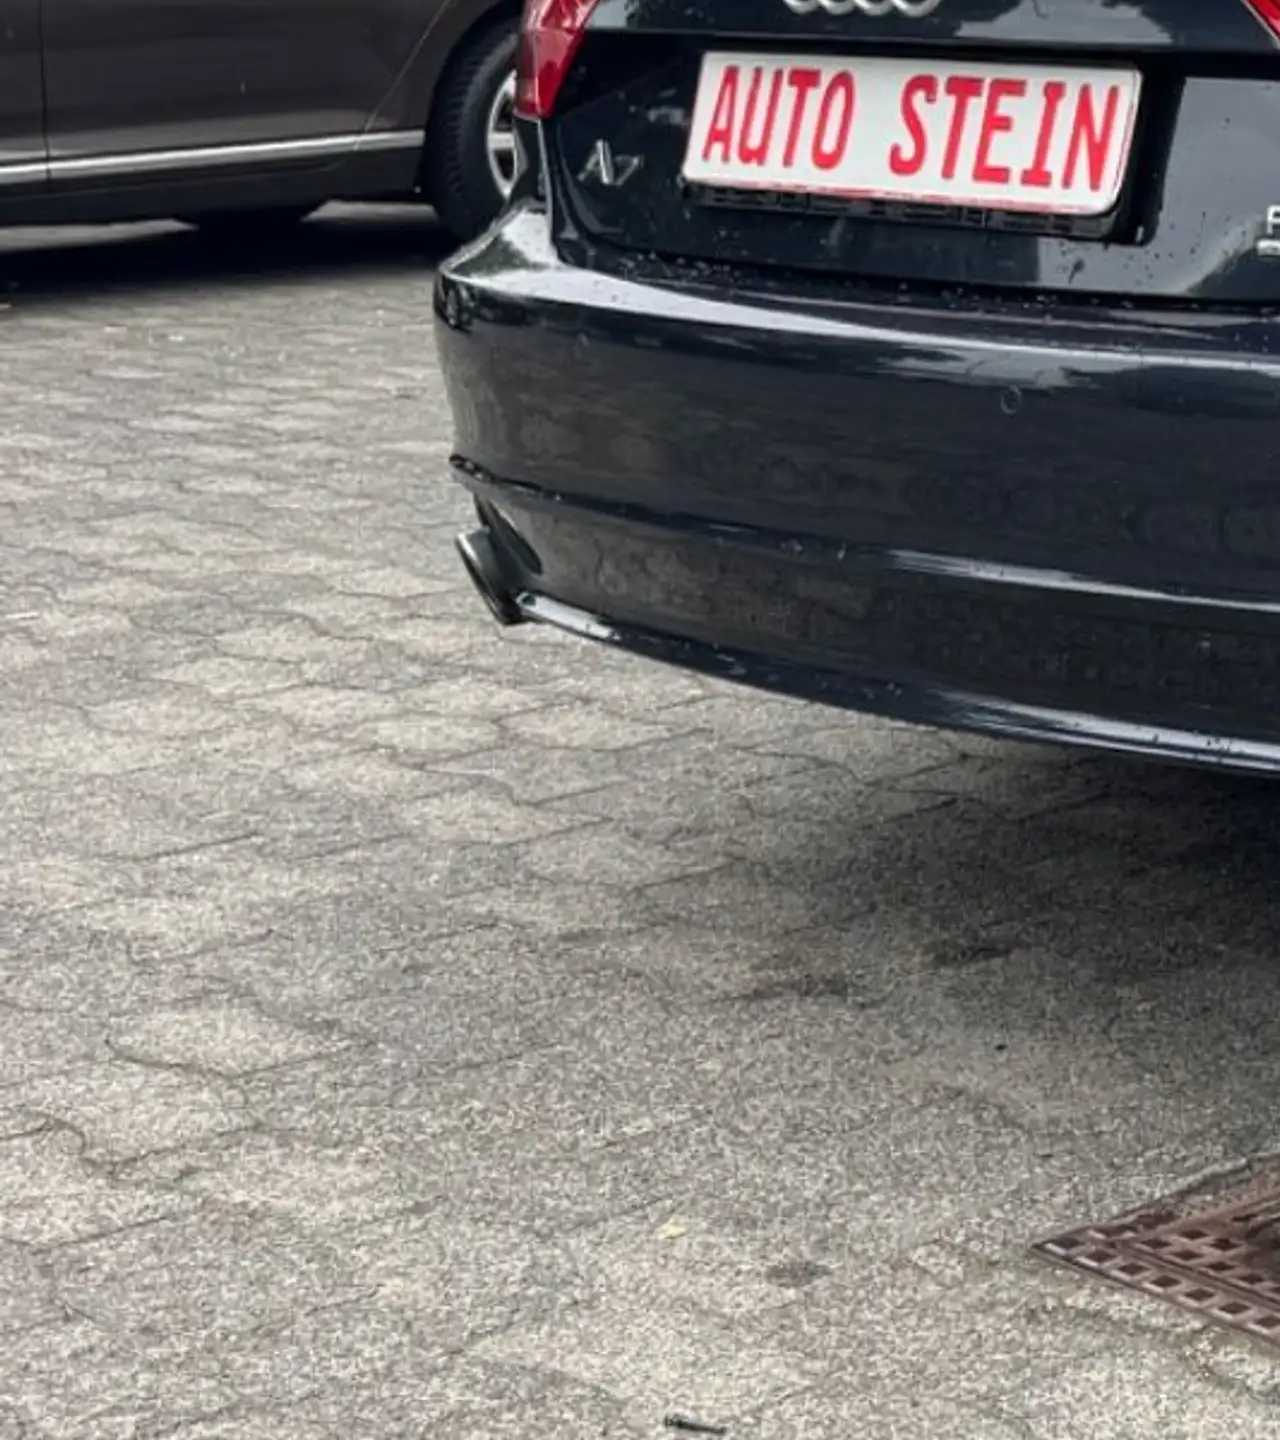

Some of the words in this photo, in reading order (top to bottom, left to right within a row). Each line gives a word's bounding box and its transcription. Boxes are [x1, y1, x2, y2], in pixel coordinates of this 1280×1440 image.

[577, 139, 644, 187] A7
[702, 64, 854, 170] AUTO
[890, 74, 1120, 192] STEIN
